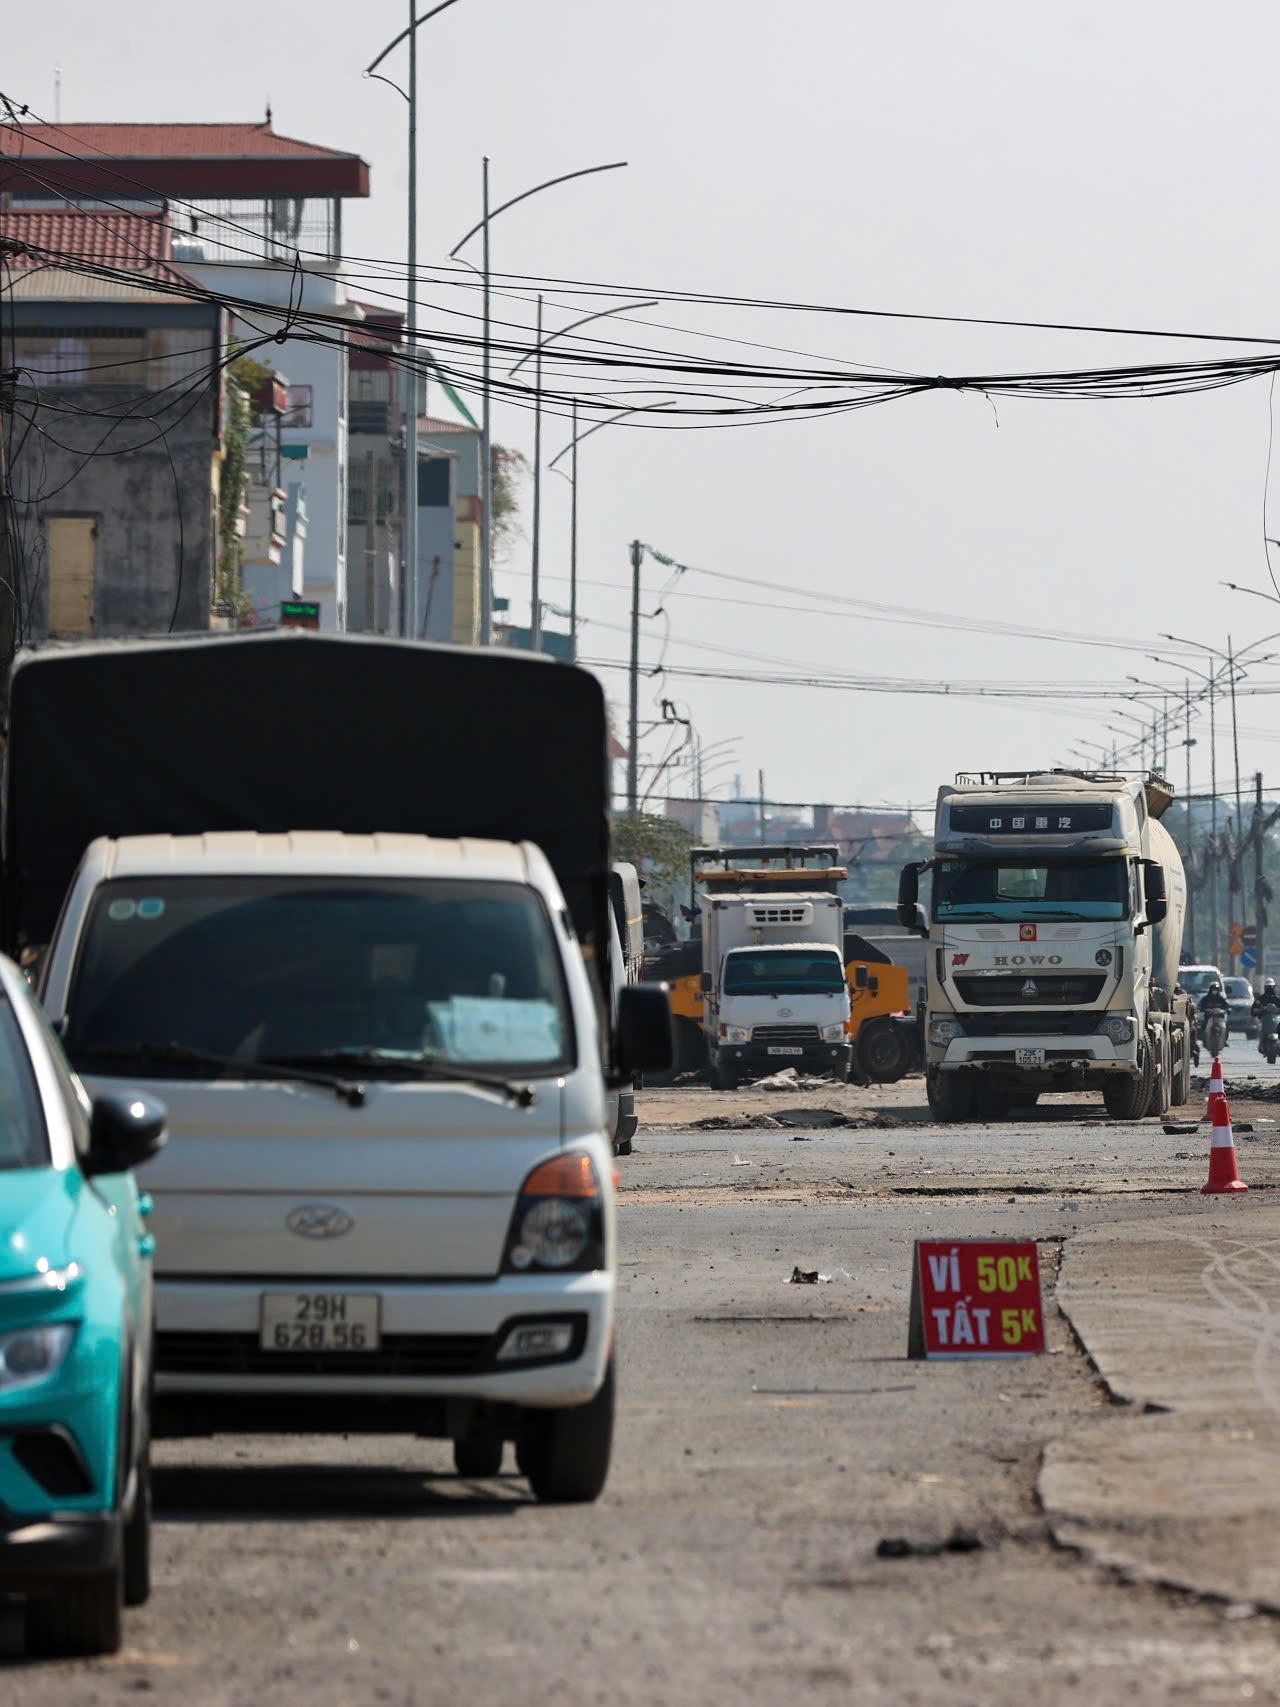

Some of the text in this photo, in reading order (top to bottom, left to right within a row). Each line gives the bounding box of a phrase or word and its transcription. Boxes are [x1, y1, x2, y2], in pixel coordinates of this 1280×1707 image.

[989, 816, 1072, 829] 中国重汽
[993, 955, 1063, 966] HOWO
[927, 1247, 1033, 1293] VÍ 50K
[295, 1294, 347, 1320] 29H
[932, 1295, 1037, 1345] TẤT 5K
